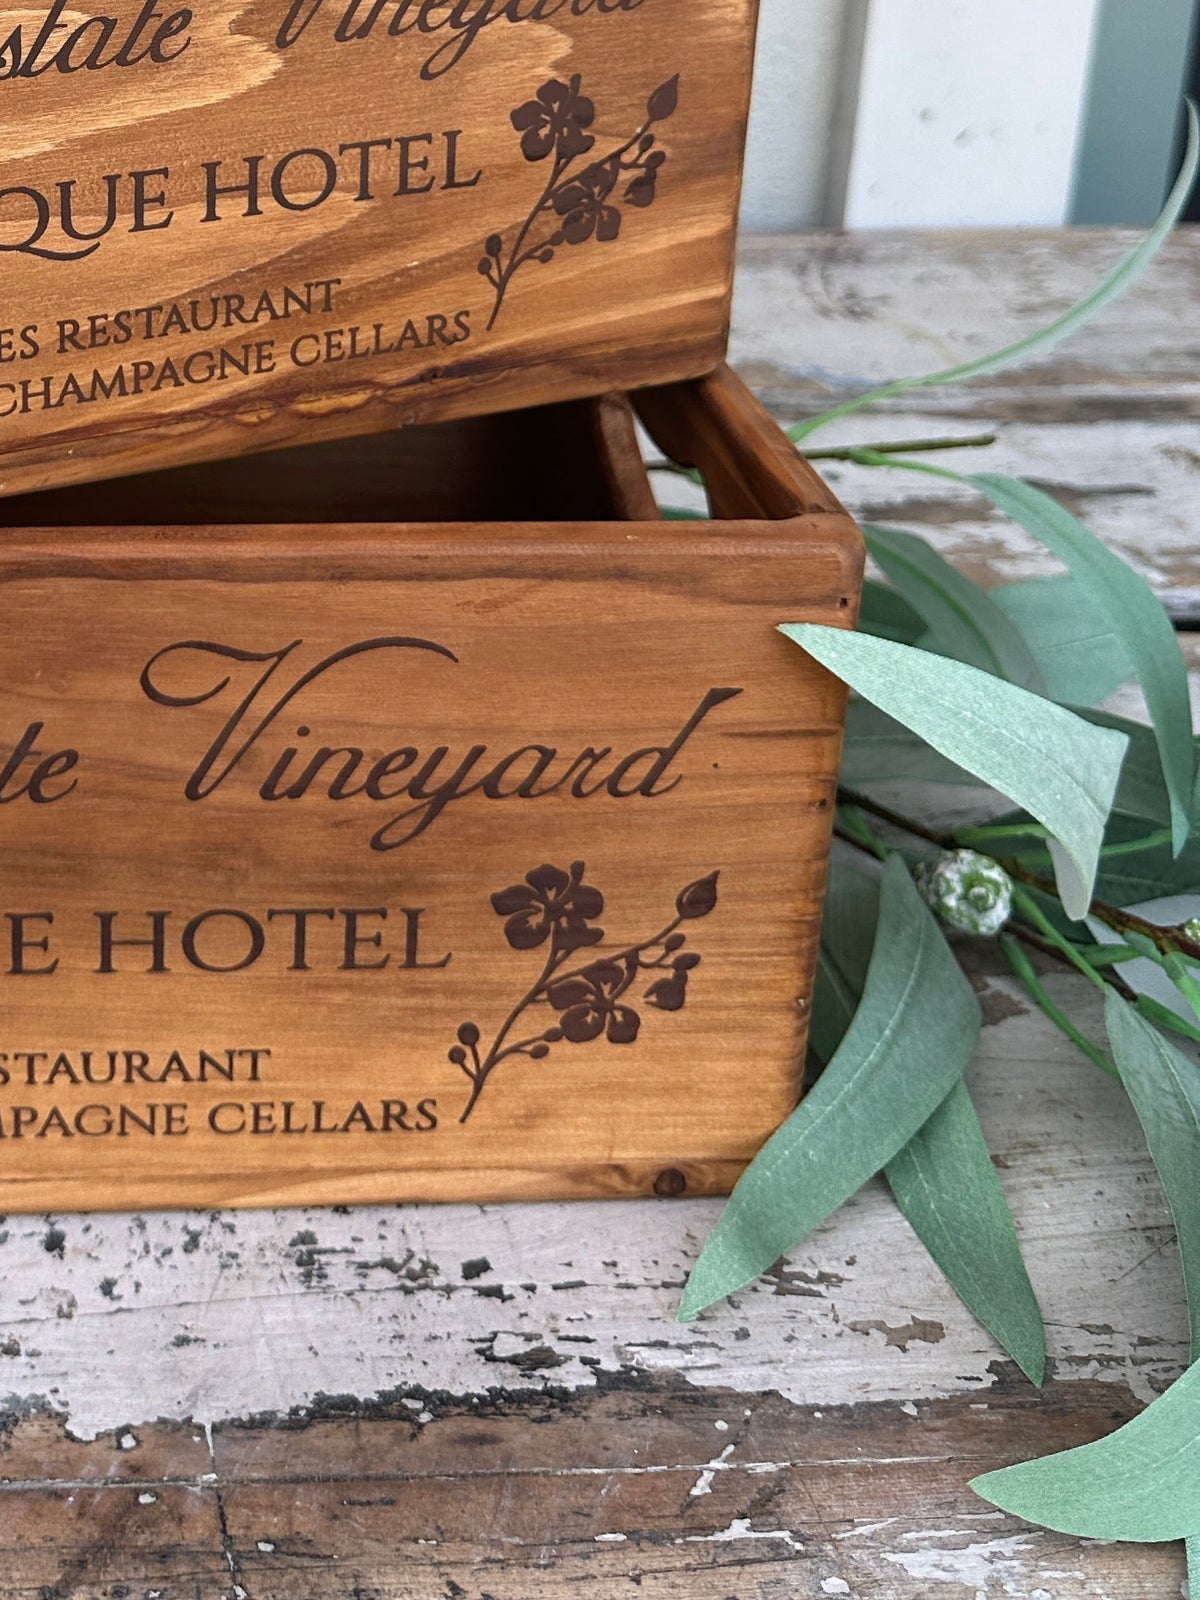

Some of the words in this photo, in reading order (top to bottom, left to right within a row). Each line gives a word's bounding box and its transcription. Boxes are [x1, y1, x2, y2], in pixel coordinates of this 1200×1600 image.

[200, 129, 480, 223] HOTEL
[55, 278, 342, 364] RESTAURANT
[289, 308, 471, 373] CELLARS
[139, 636, 743, 853] Vineyard
[94, 905, 452, 977] HOTEL
[211, 1097, 438, 1137] CELLARS
